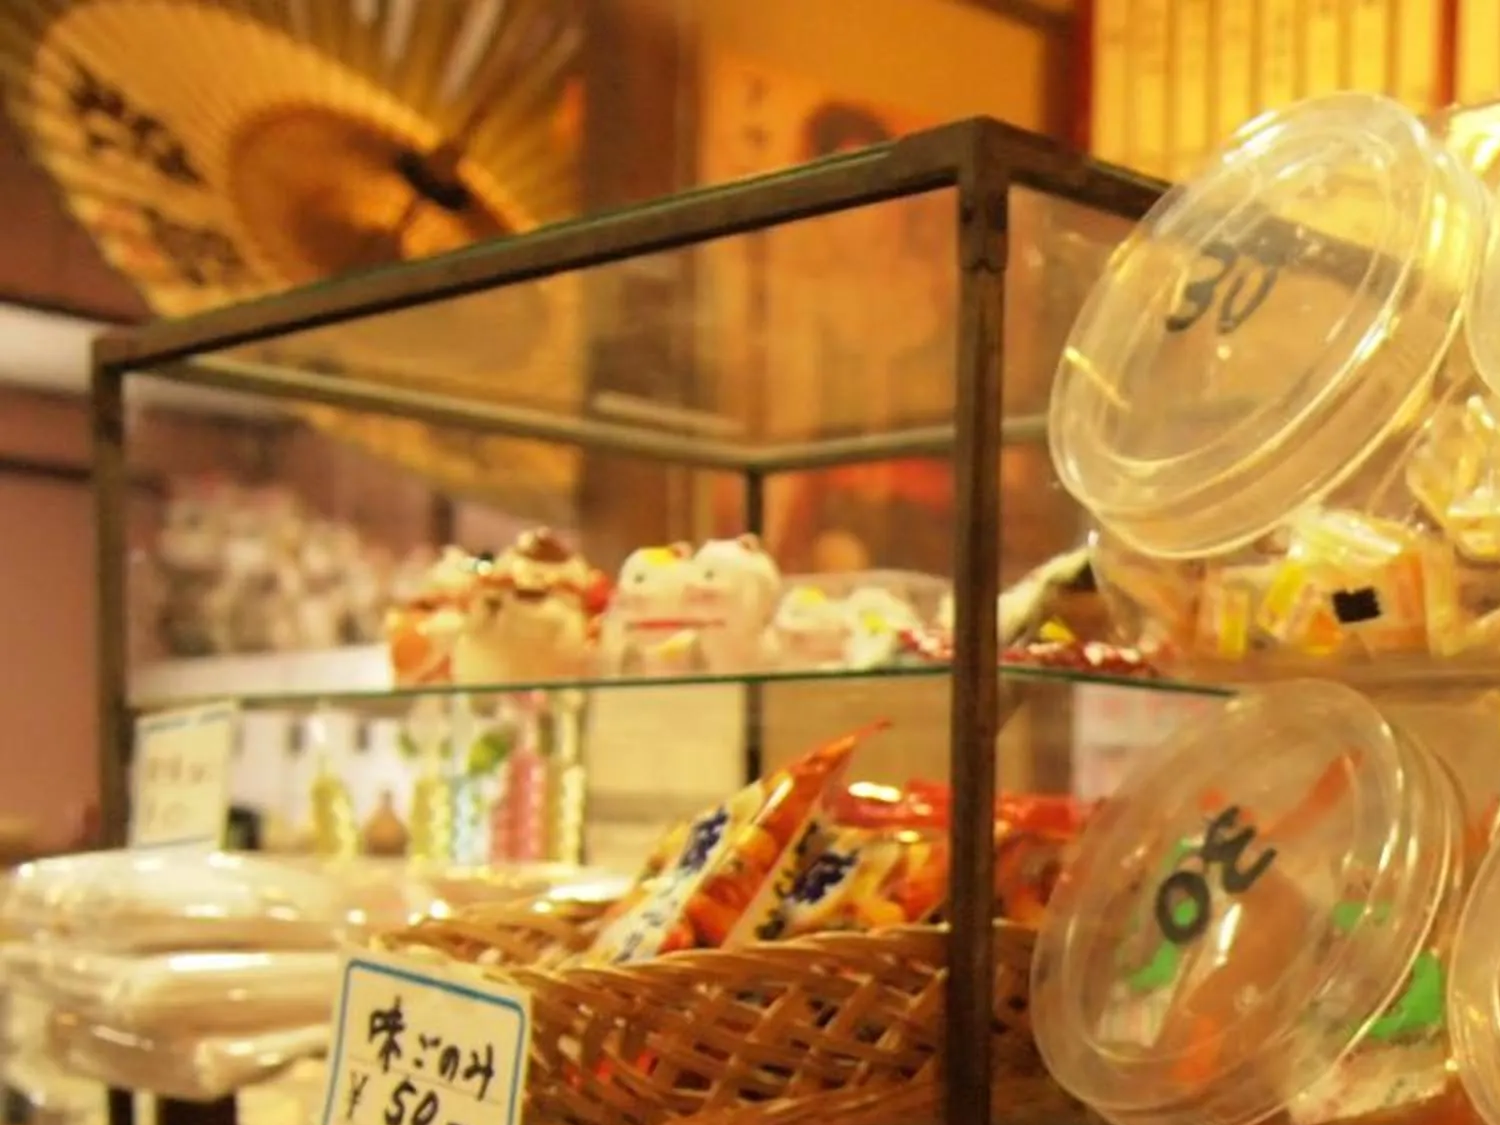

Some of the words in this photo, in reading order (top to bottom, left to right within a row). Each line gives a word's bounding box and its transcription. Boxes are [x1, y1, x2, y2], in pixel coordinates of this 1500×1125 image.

[1165, 242, 1281, 334] 30
[1155, 805, 1278, 944] 30
[368, 996, 495, 1102] 味ごのみ
